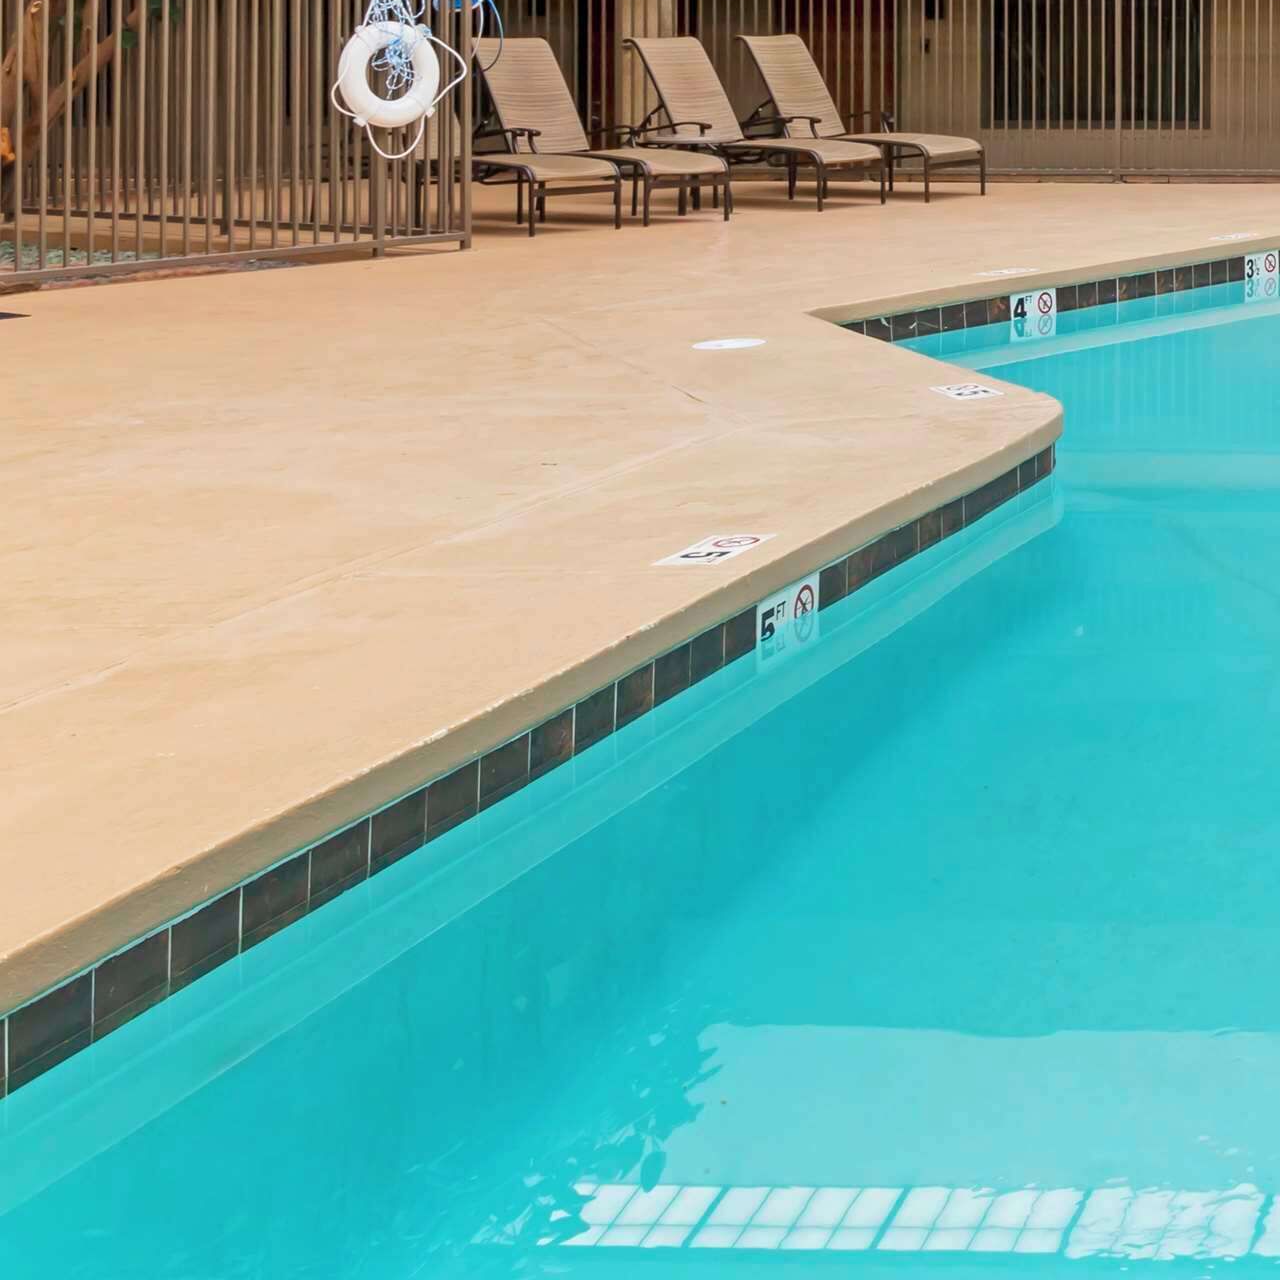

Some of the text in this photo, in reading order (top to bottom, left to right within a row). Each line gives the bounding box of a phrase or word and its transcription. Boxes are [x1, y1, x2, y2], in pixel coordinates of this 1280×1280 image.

[1013, 297, 1027, 319] 4
[760, 600, 787, 642] 5 FT
